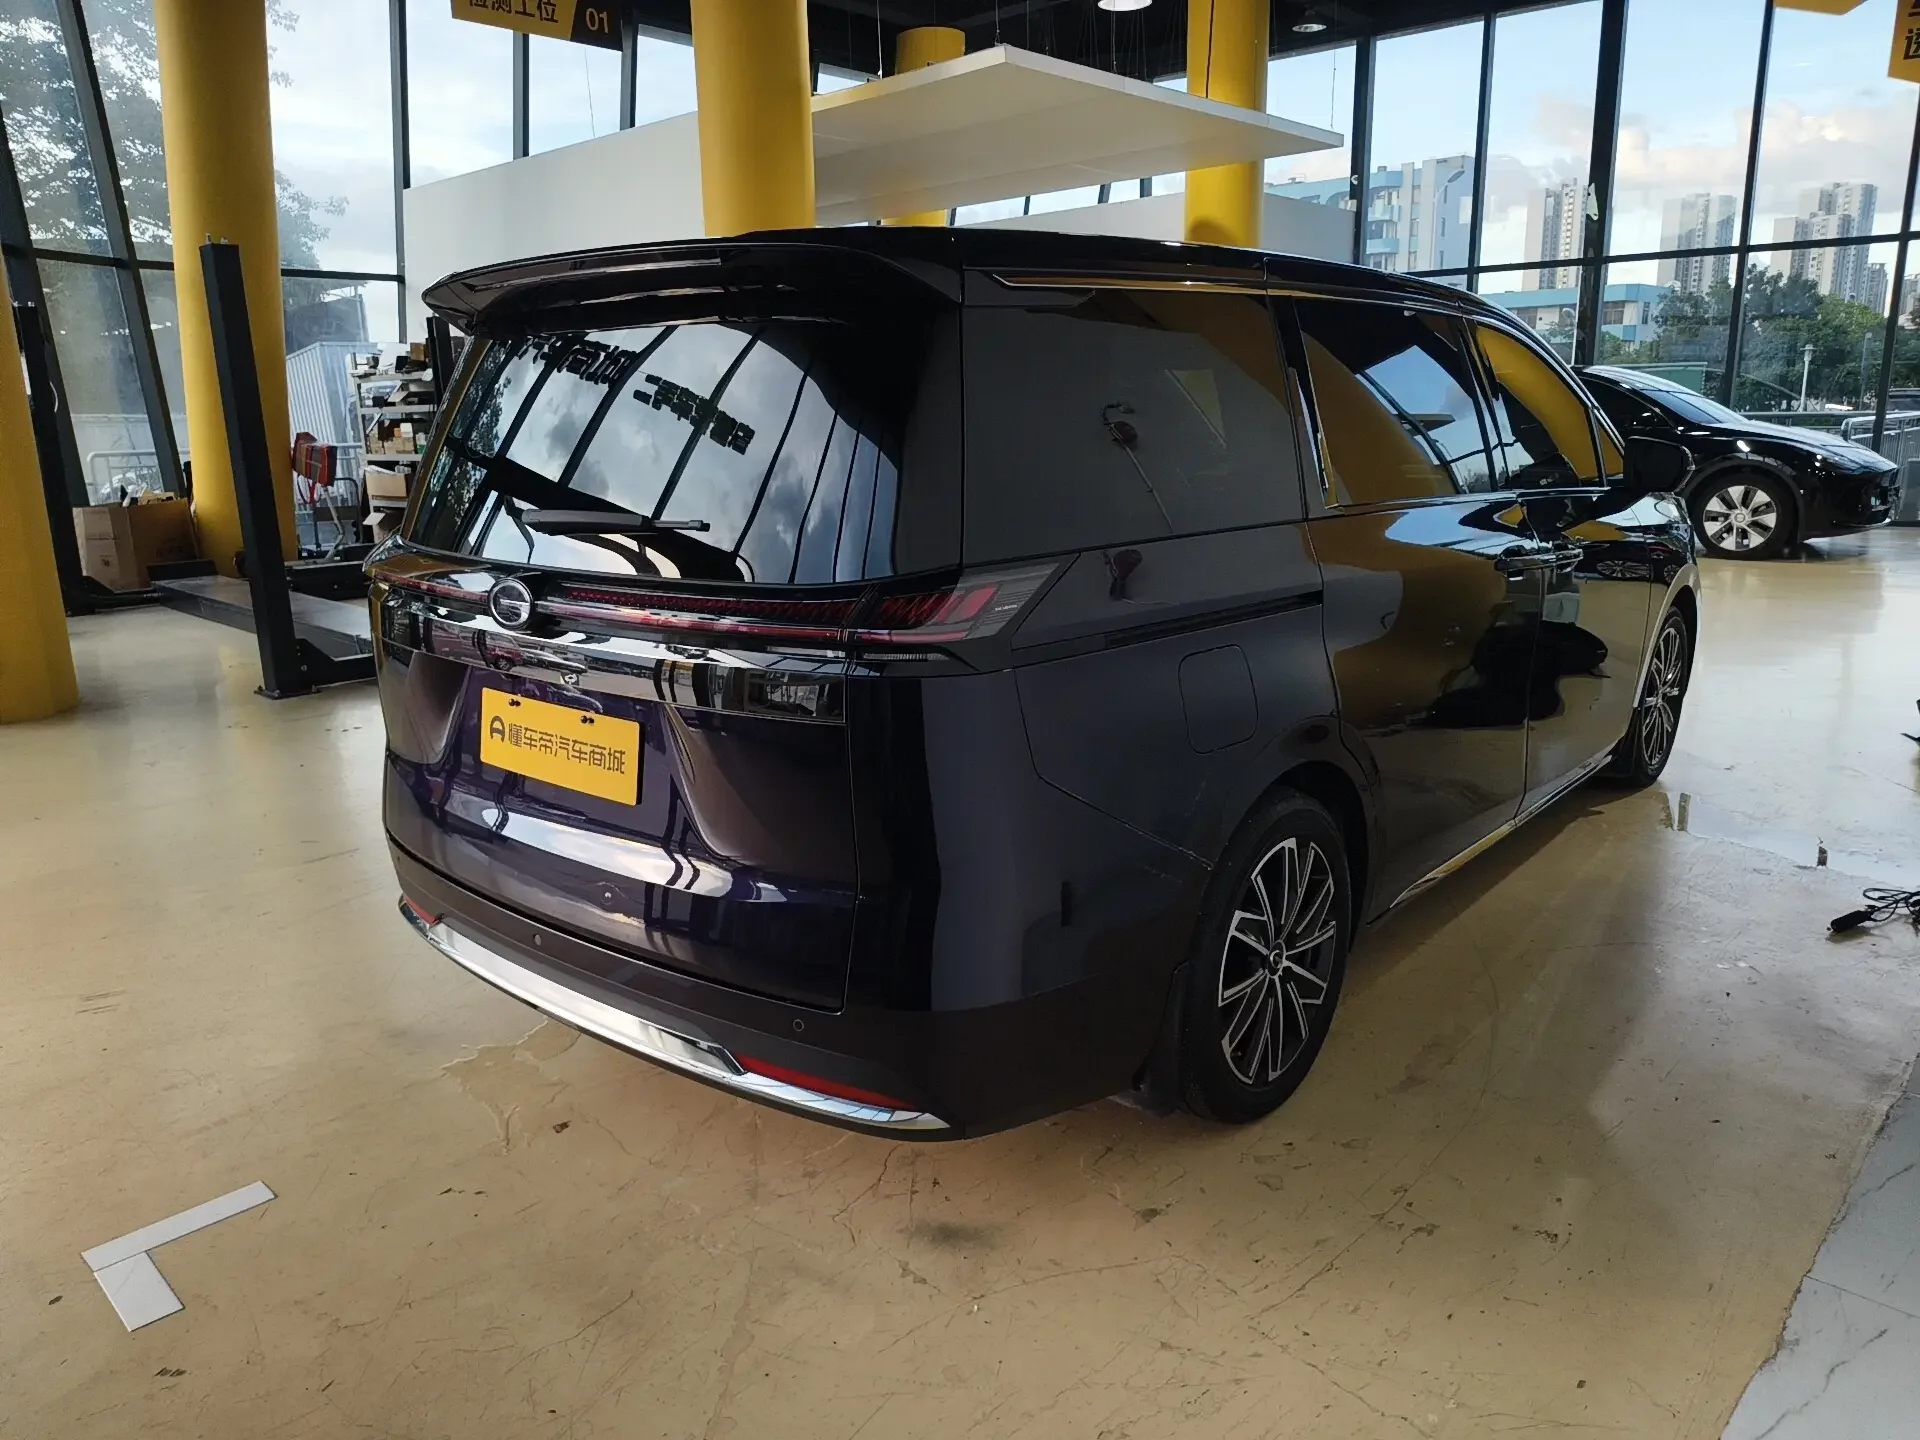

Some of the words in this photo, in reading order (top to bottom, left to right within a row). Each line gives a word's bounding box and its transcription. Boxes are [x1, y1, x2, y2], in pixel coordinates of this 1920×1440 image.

[585, 8, 609, 34] 01
[508, 722, 626, 775] 懂车帝汽车商城
